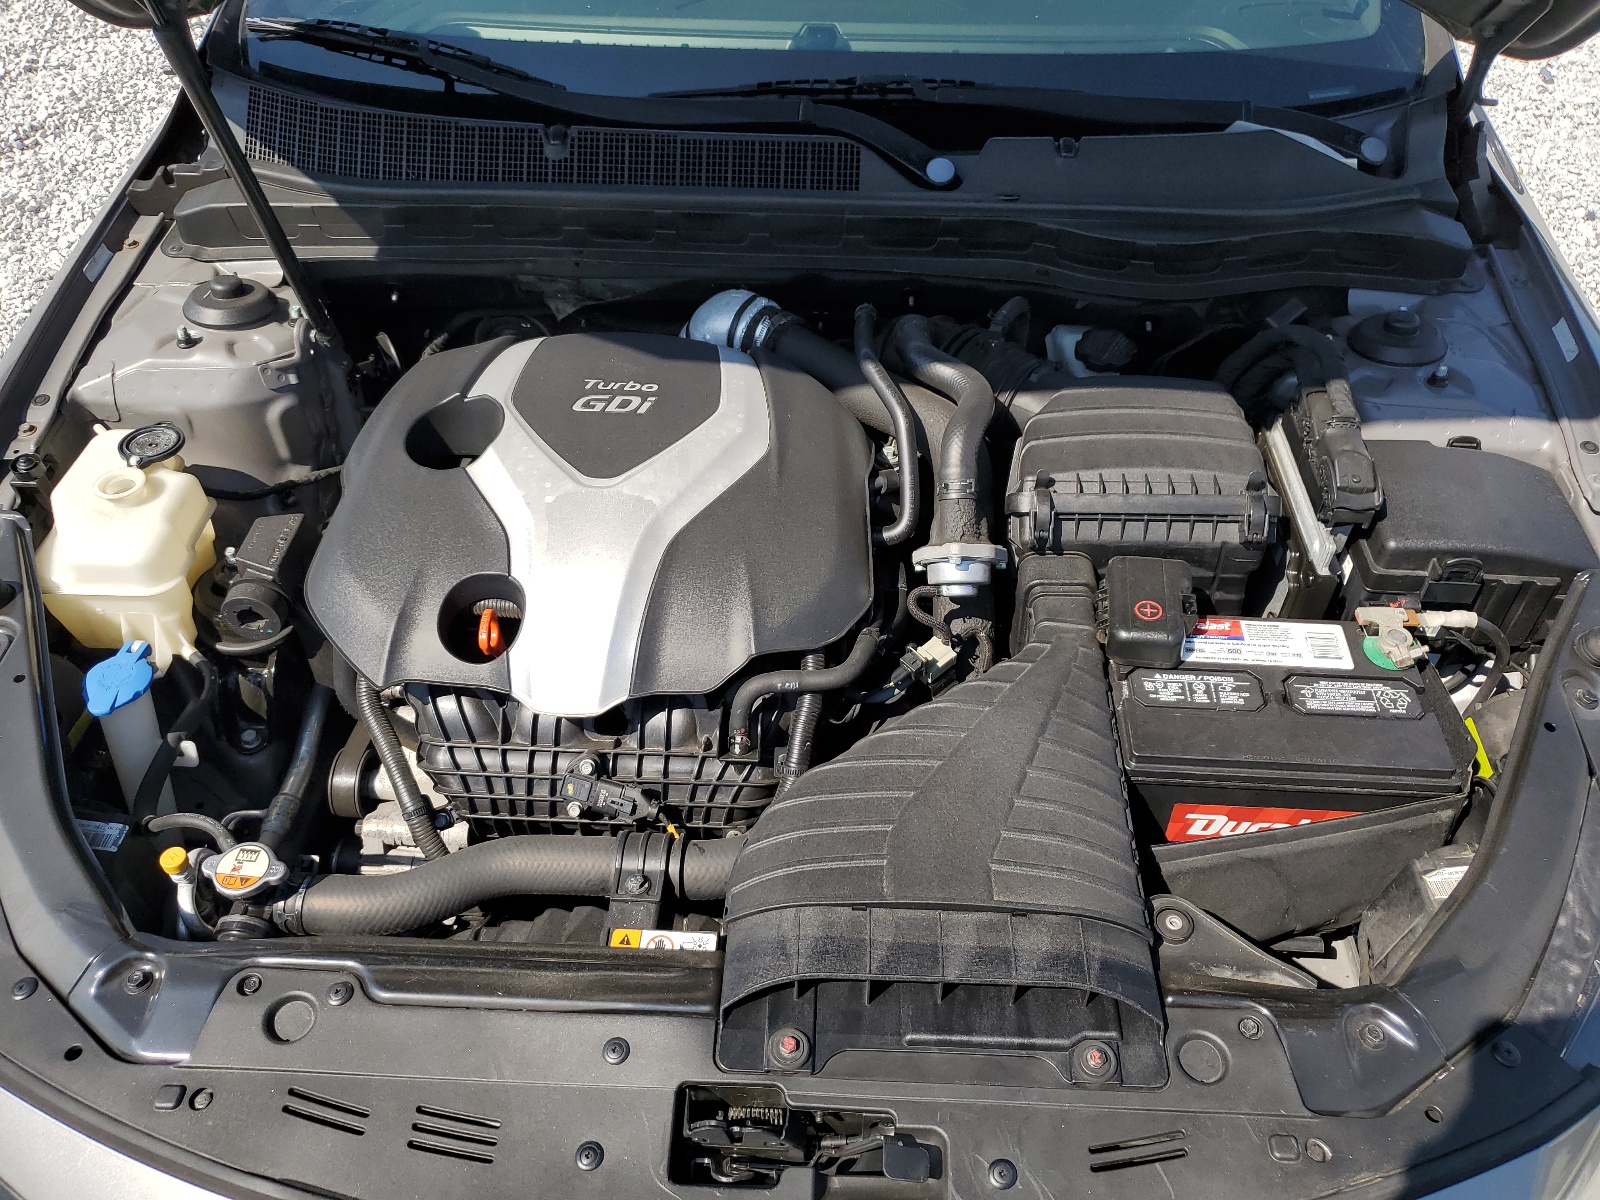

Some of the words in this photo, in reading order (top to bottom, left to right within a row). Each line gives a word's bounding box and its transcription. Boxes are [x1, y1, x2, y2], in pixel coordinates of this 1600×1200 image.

[584, 379, 659, 392] Turbo
[572, 394, 659, 414] GDi
[1162, 673, 1196, 681] DANGER
[1203, 675, 1234, 683] POISON
